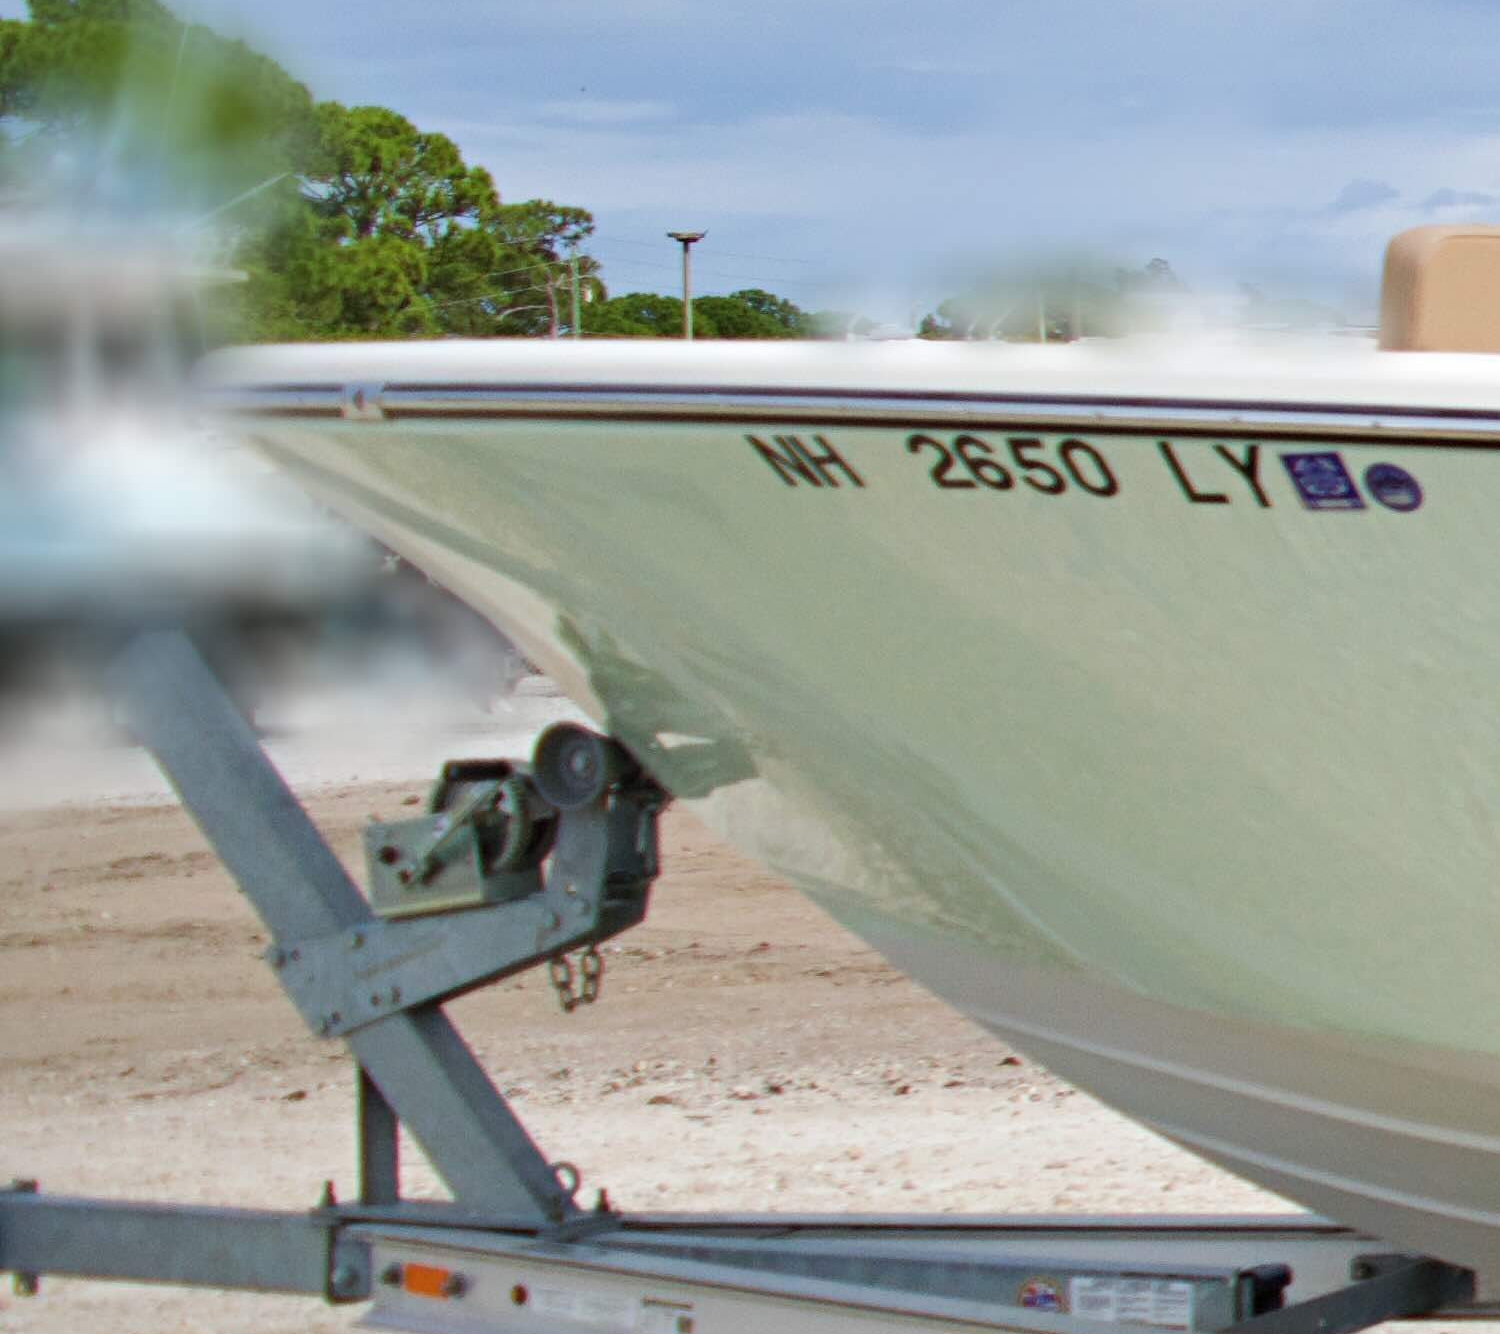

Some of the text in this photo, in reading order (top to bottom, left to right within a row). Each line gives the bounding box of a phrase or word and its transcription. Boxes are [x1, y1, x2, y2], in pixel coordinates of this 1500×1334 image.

[746, 434, 866, 489] NH
[905, 434, 1120, 498] 2650
[1157, 440, 1274, 508] LY
